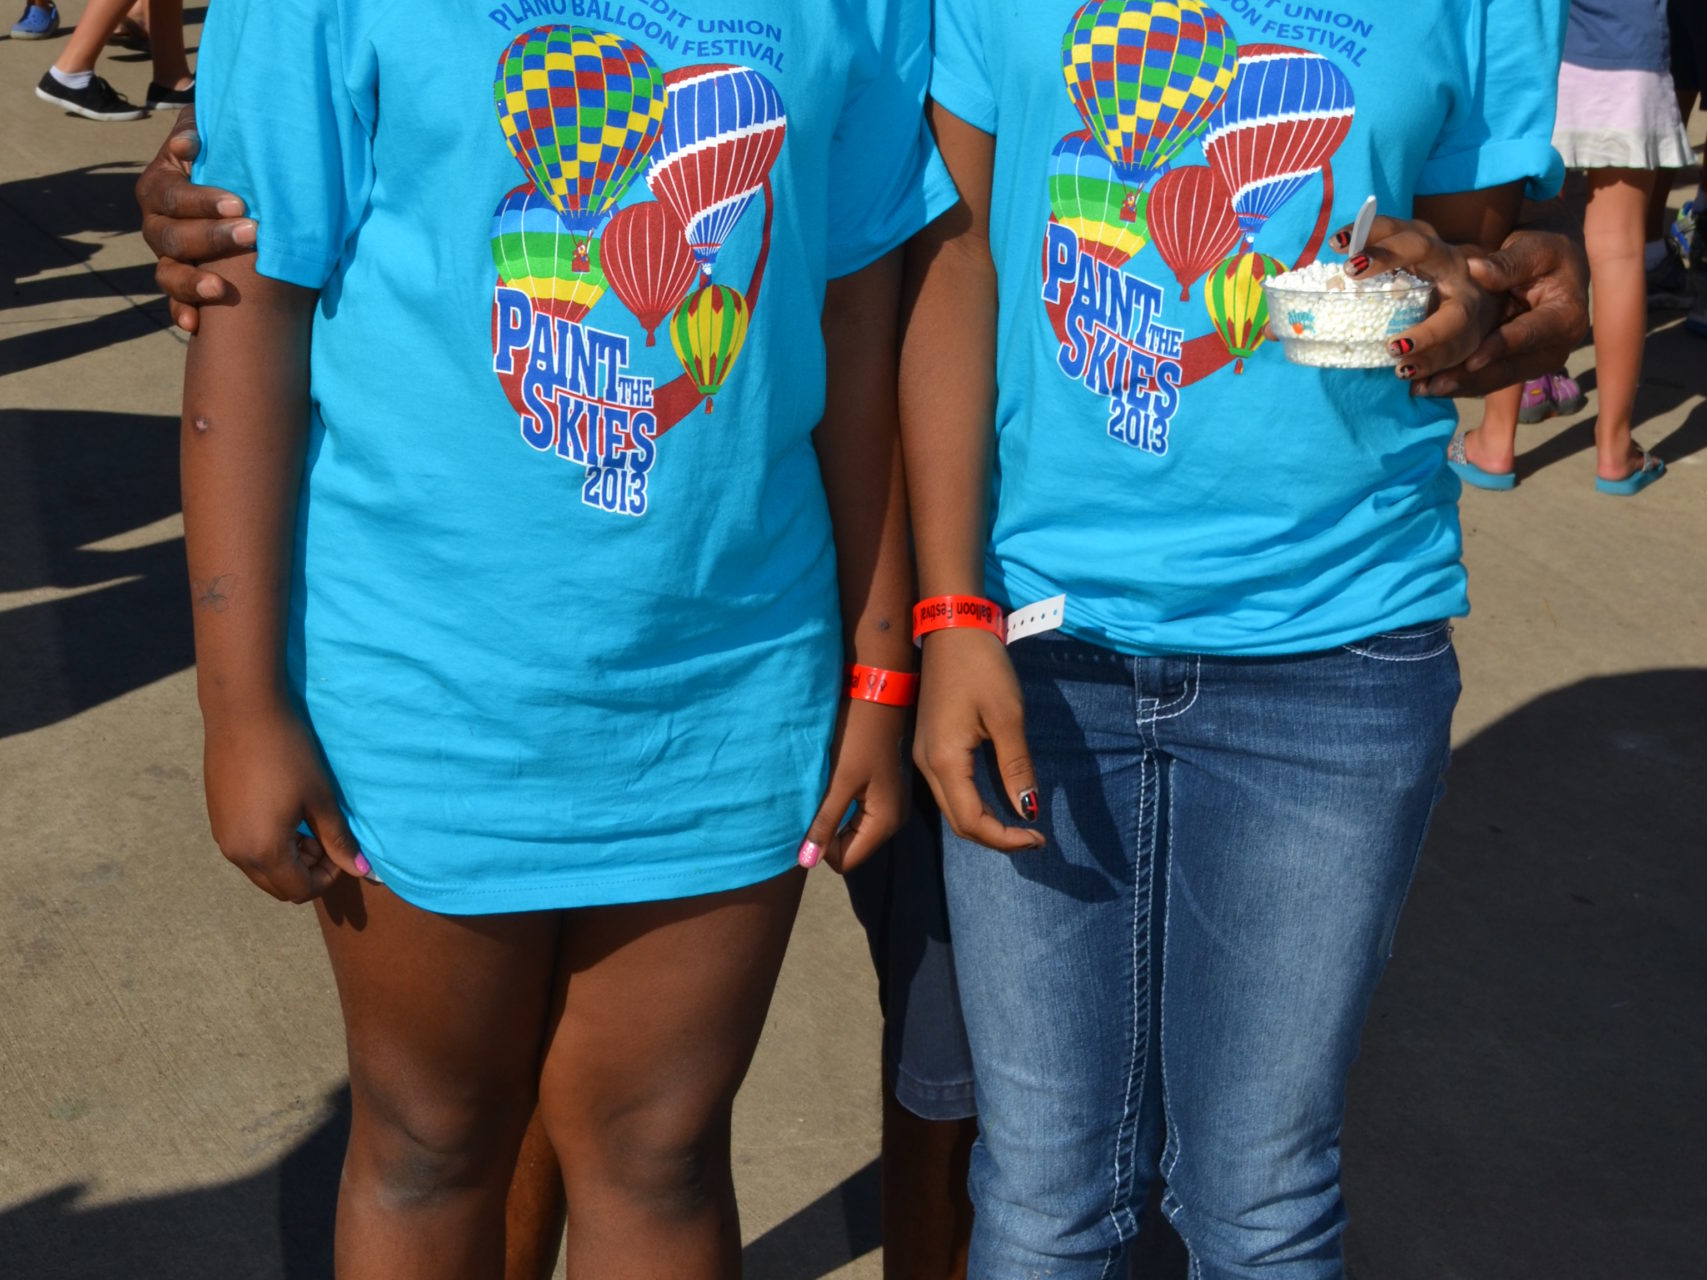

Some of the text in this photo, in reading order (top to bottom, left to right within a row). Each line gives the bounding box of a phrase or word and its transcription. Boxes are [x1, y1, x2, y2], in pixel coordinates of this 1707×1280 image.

[698, 19, 782, 42] UNION
[1262, 19, 1368, 68] FESTIVAL
[1284, 2, 1374, 39] UNION
[682, 39, 785, 74] FESTIVAL
[1041, 220, 1184, 360] PAINT THE
[493, 285, 654, 408] PAINT THE
[1057, 315, 1183, 421] SKIES
[521, 370, 656, 474] SKIES
[1107, 399, 1169, 458] 2013
[581, 465, 648, 517] 2013
[920, 602, 992, 625] Balloon Festival
